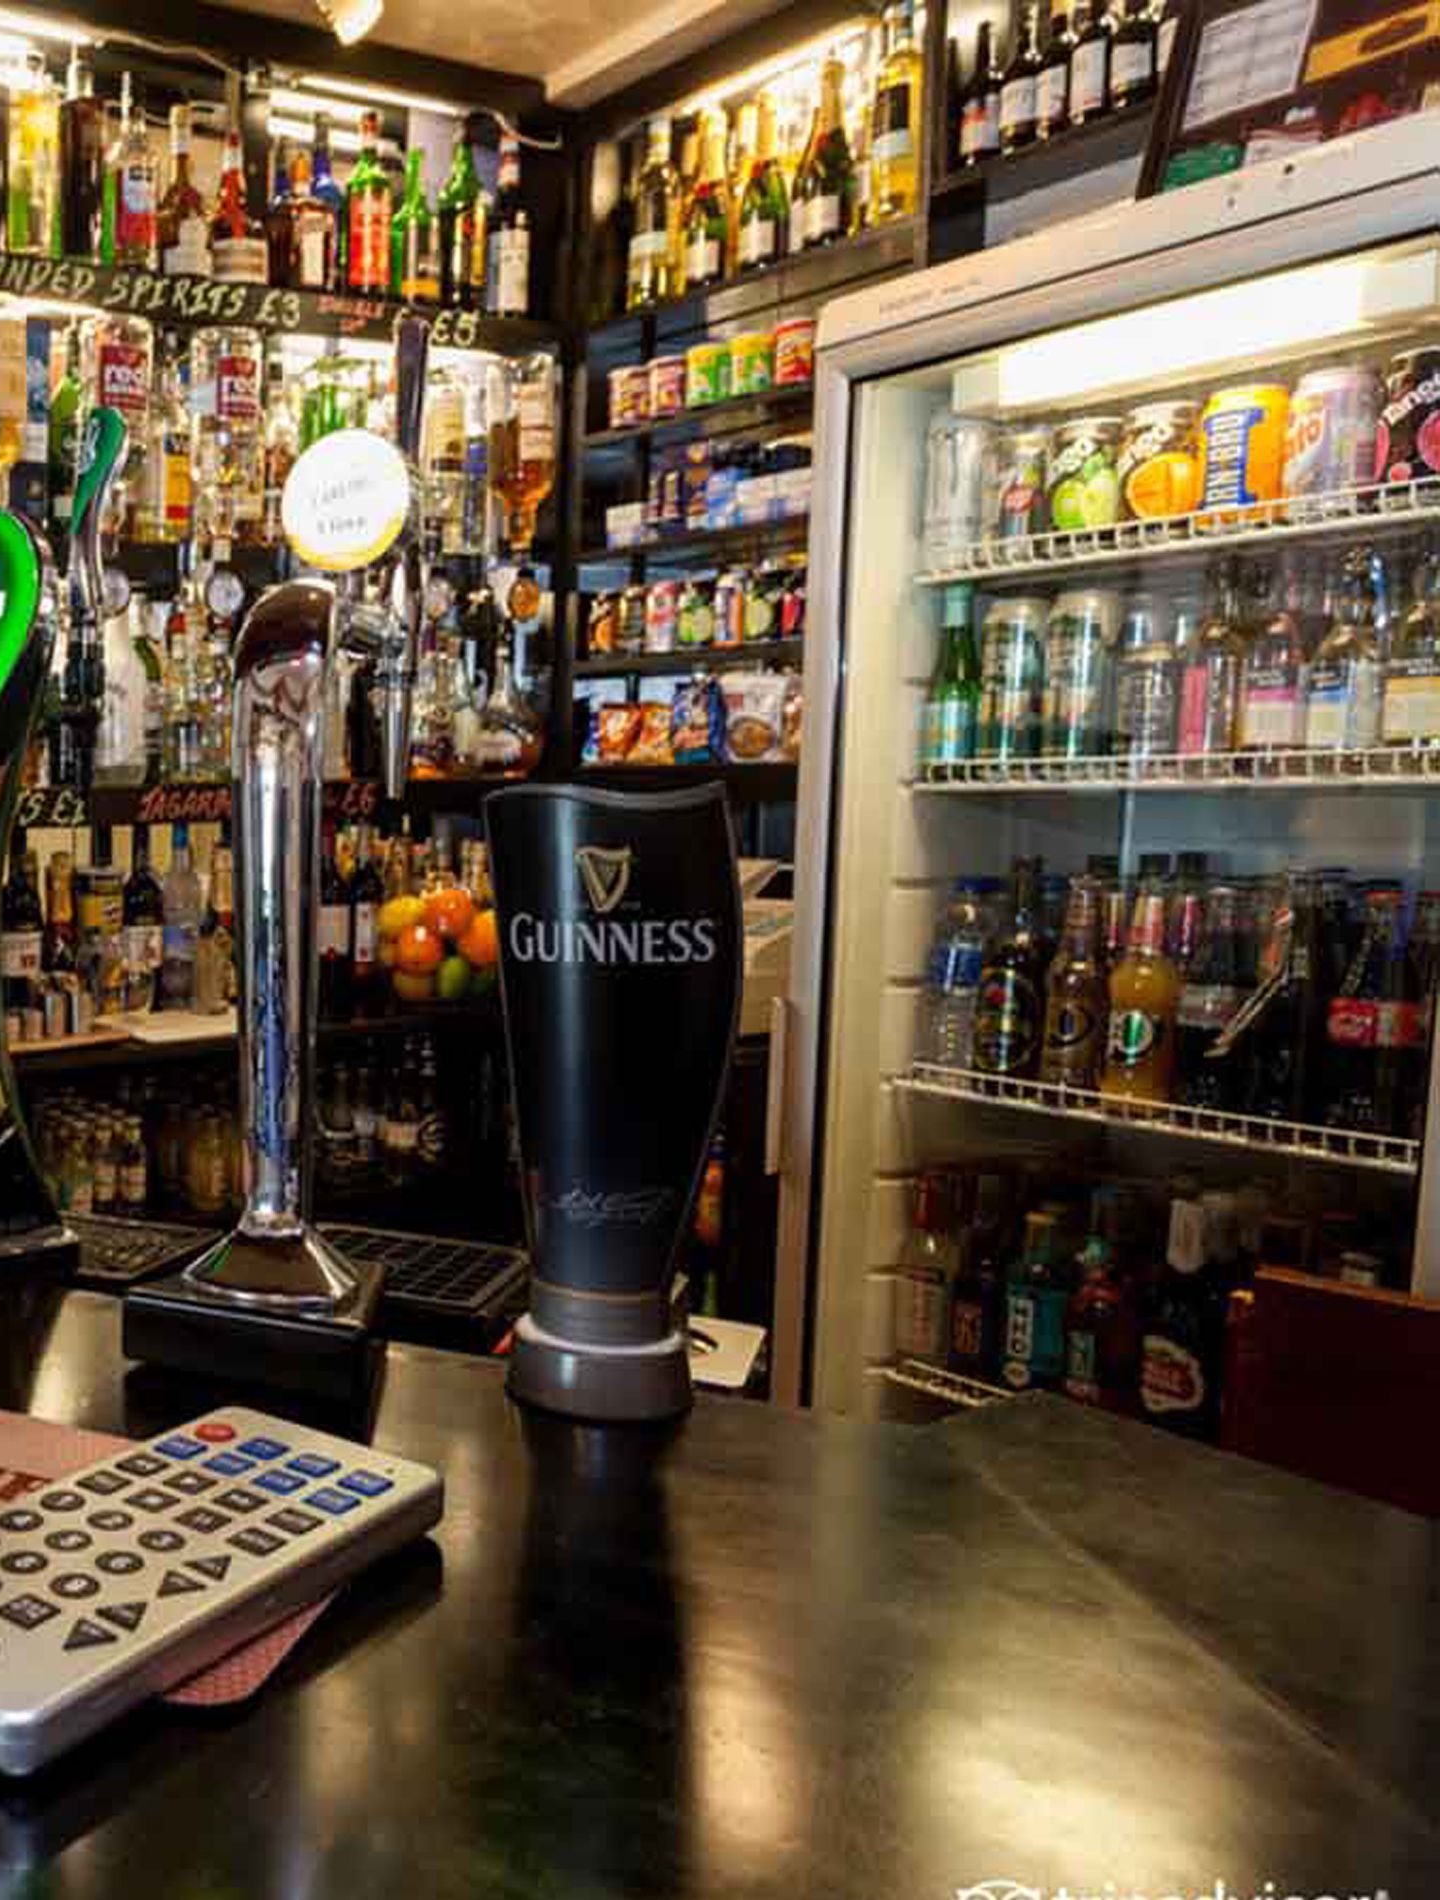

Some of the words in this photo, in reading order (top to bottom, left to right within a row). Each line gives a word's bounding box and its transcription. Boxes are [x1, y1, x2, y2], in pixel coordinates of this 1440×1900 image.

[101, 270, 247, 319] SPIRITS
[256, 288, 301, 329] £3
[509, 911, 718, 964] GUINNESS
